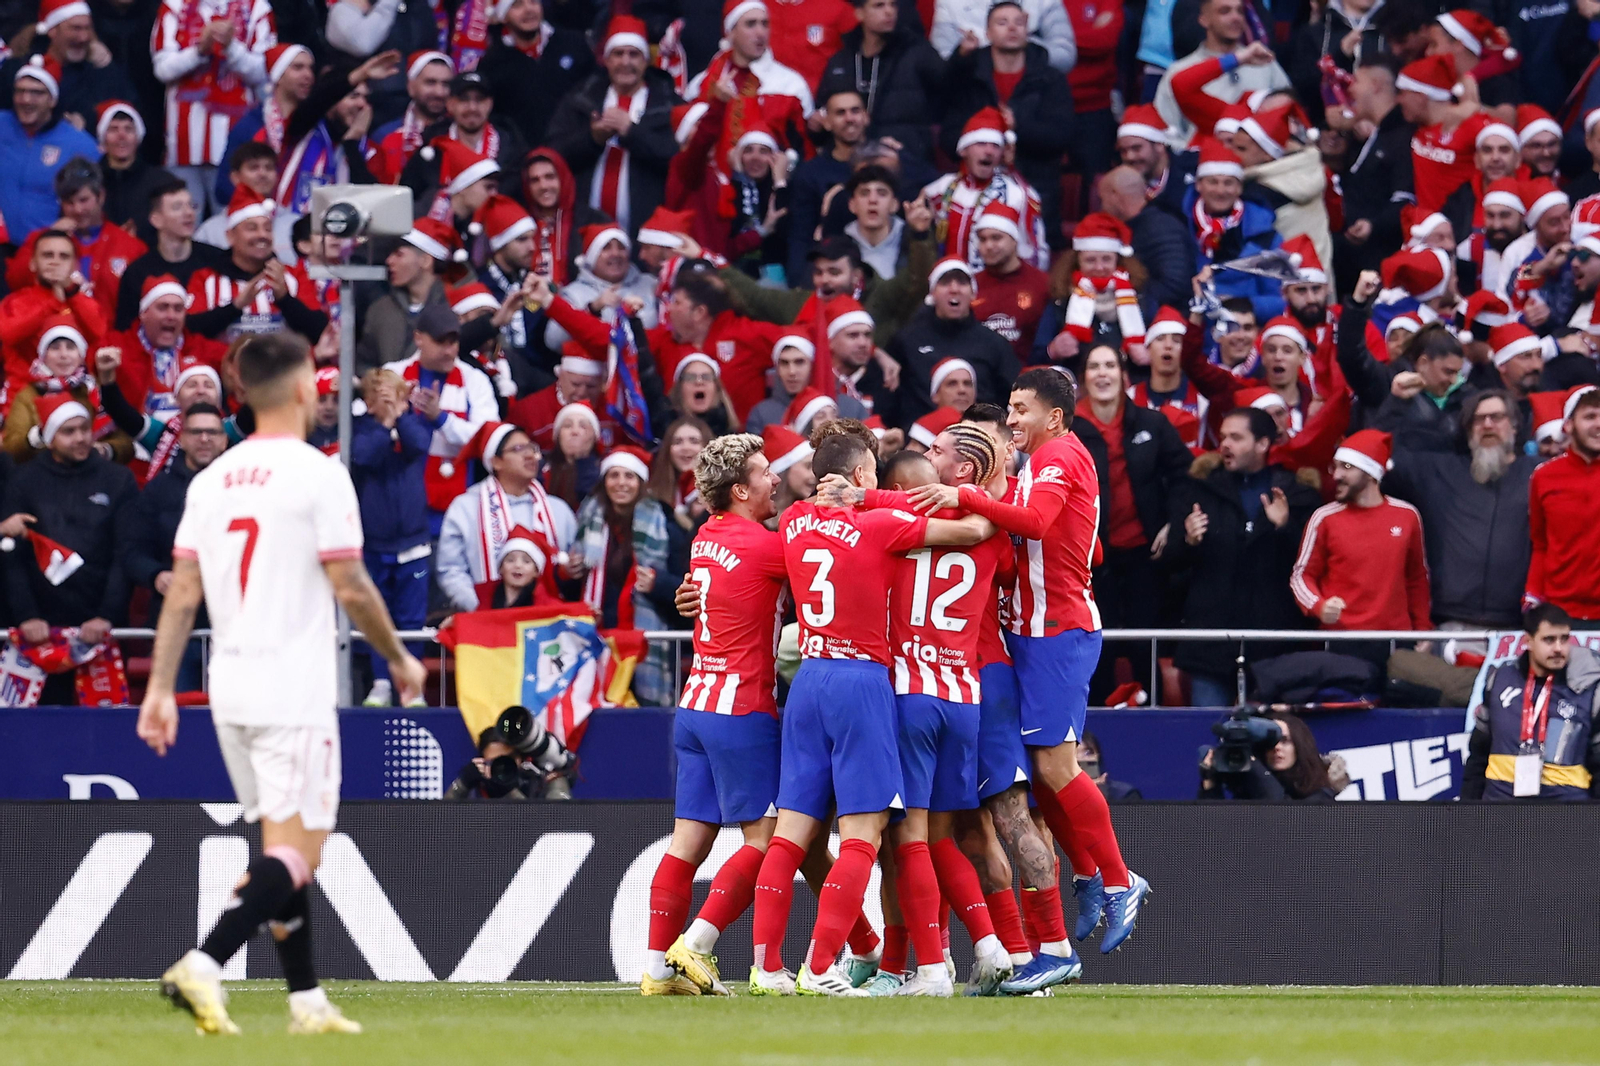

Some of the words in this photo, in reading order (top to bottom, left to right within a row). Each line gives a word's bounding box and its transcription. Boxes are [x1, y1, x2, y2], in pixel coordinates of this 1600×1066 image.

[785, 513, 862, 548] AZPILICUETA
[226, 516, 260, 612] 7
[801, 549, 835, 628] 3
[905, 548, 976, 632] 12
[702, 655, 727, 666] Money
[901, 634, 937, 663] ria
[938, 655, 967, 667] Transfer
[939, 646, 965, 659] Money
[702, 662, 728, 672] Transfer
